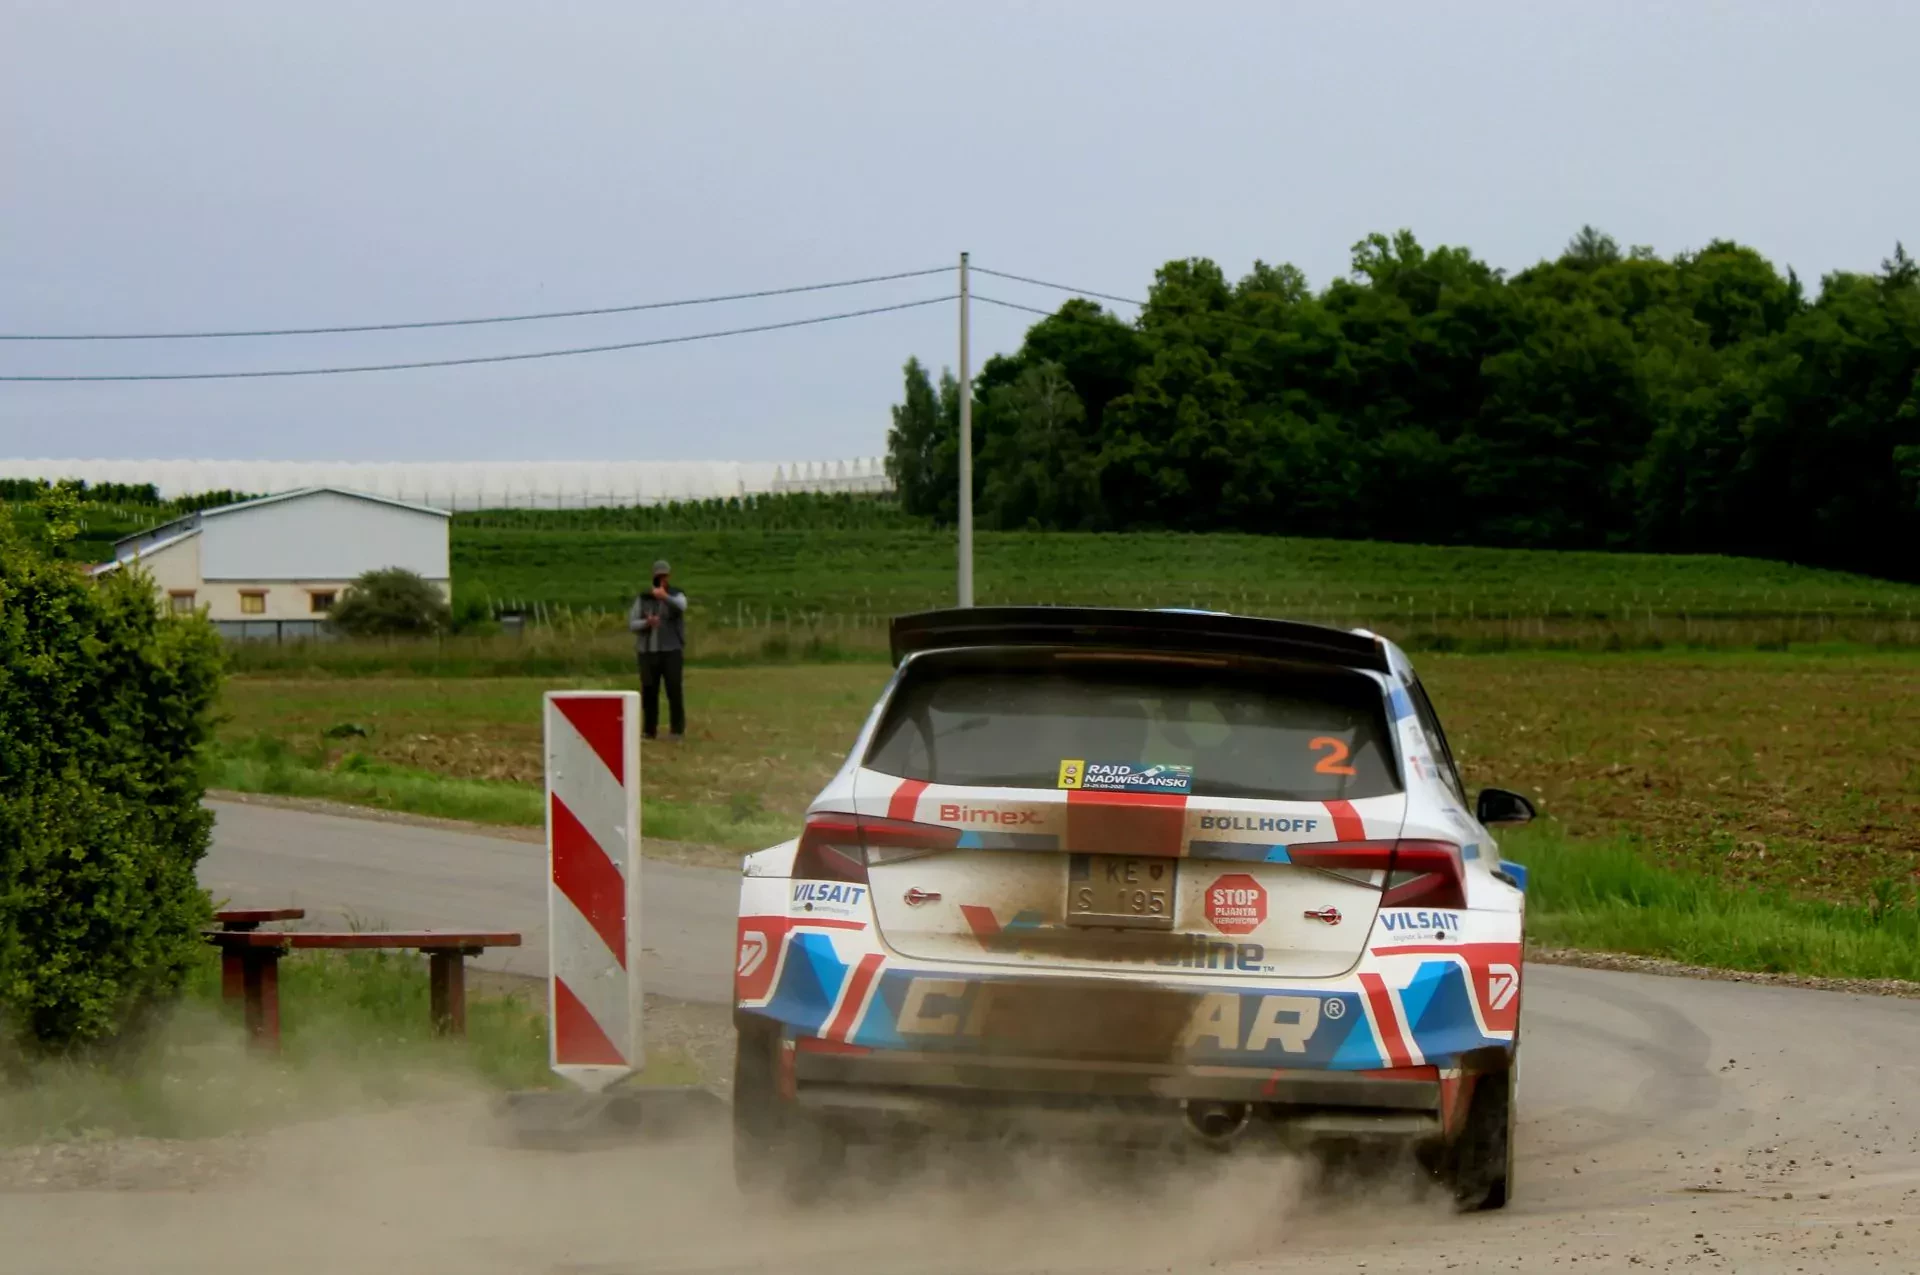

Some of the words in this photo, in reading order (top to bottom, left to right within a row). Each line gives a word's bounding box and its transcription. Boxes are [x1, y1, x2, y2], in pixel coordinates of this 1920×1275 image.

[1309, 737, 1356, 775] 2
[1088, 764, 1130, 776] RAJD
[940, 804, 1043, 825] Bimex
[1106, 860, 1138, 884] KE
[793, 884, 865, 905] VILSAIT
[1078, 887, 1093, 908] S
[1213, 889, 1259, 906] STOP
[1215, 907, 1257, 916] PIJANYM
[1380, 912, 1458, 931] VILSAIT
